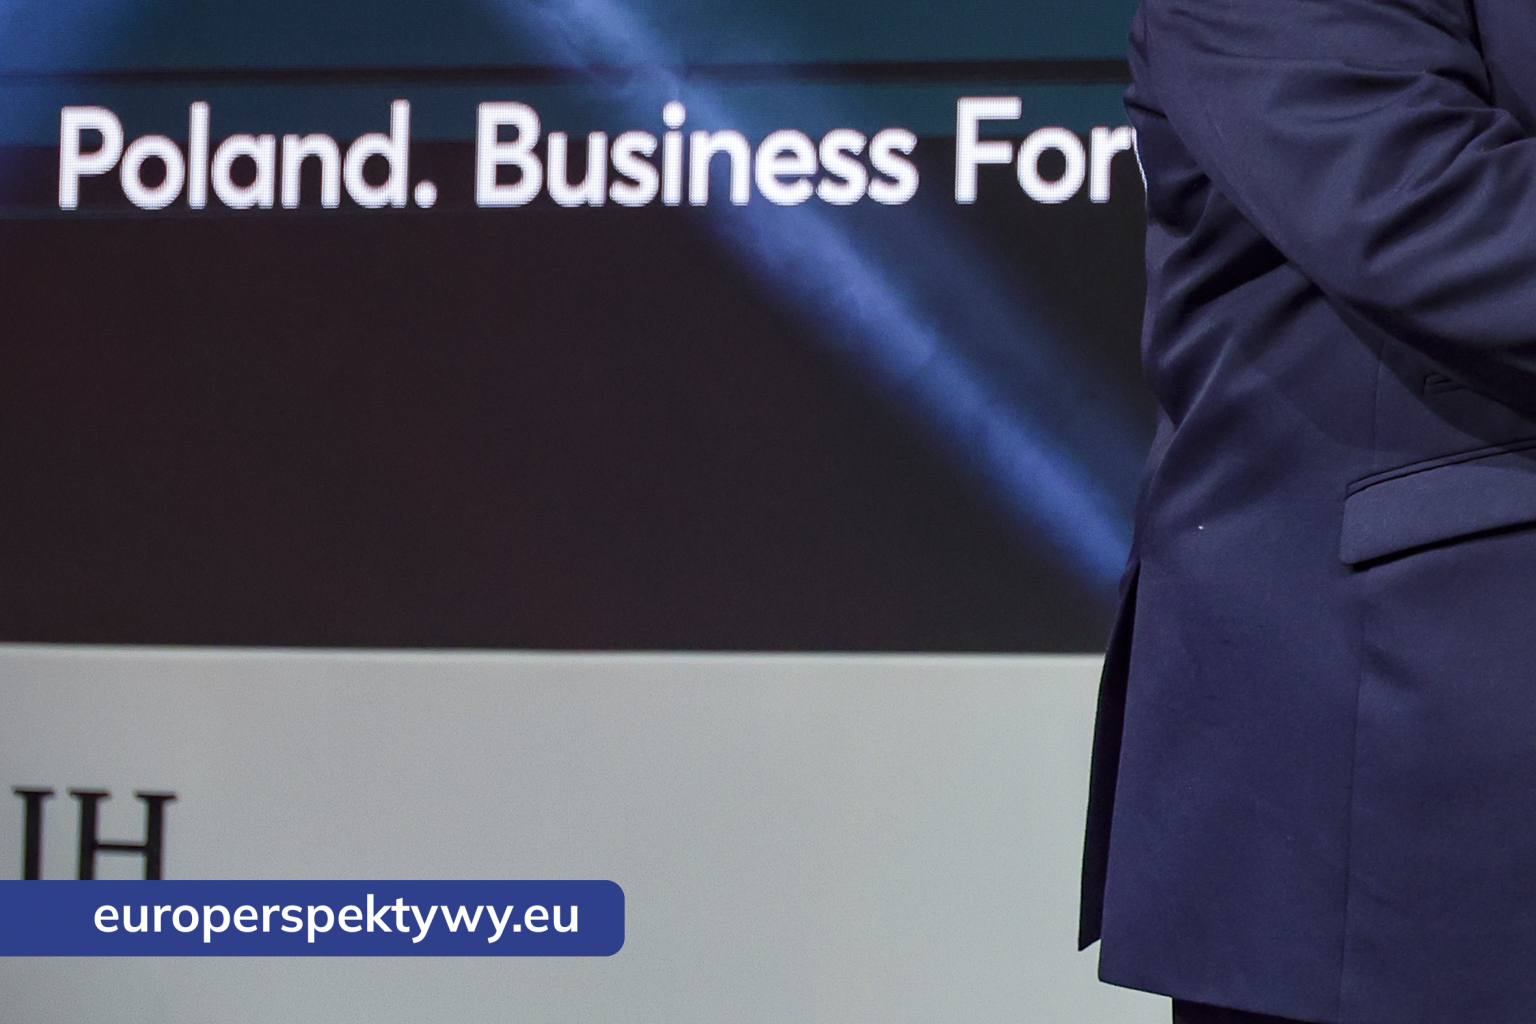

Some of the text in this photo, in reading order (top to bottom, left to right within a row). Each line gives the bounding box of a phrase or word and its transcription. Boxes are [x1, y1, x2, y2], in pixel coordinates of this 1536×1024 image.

[57, 95, 1142, 211] Poland. Business For
